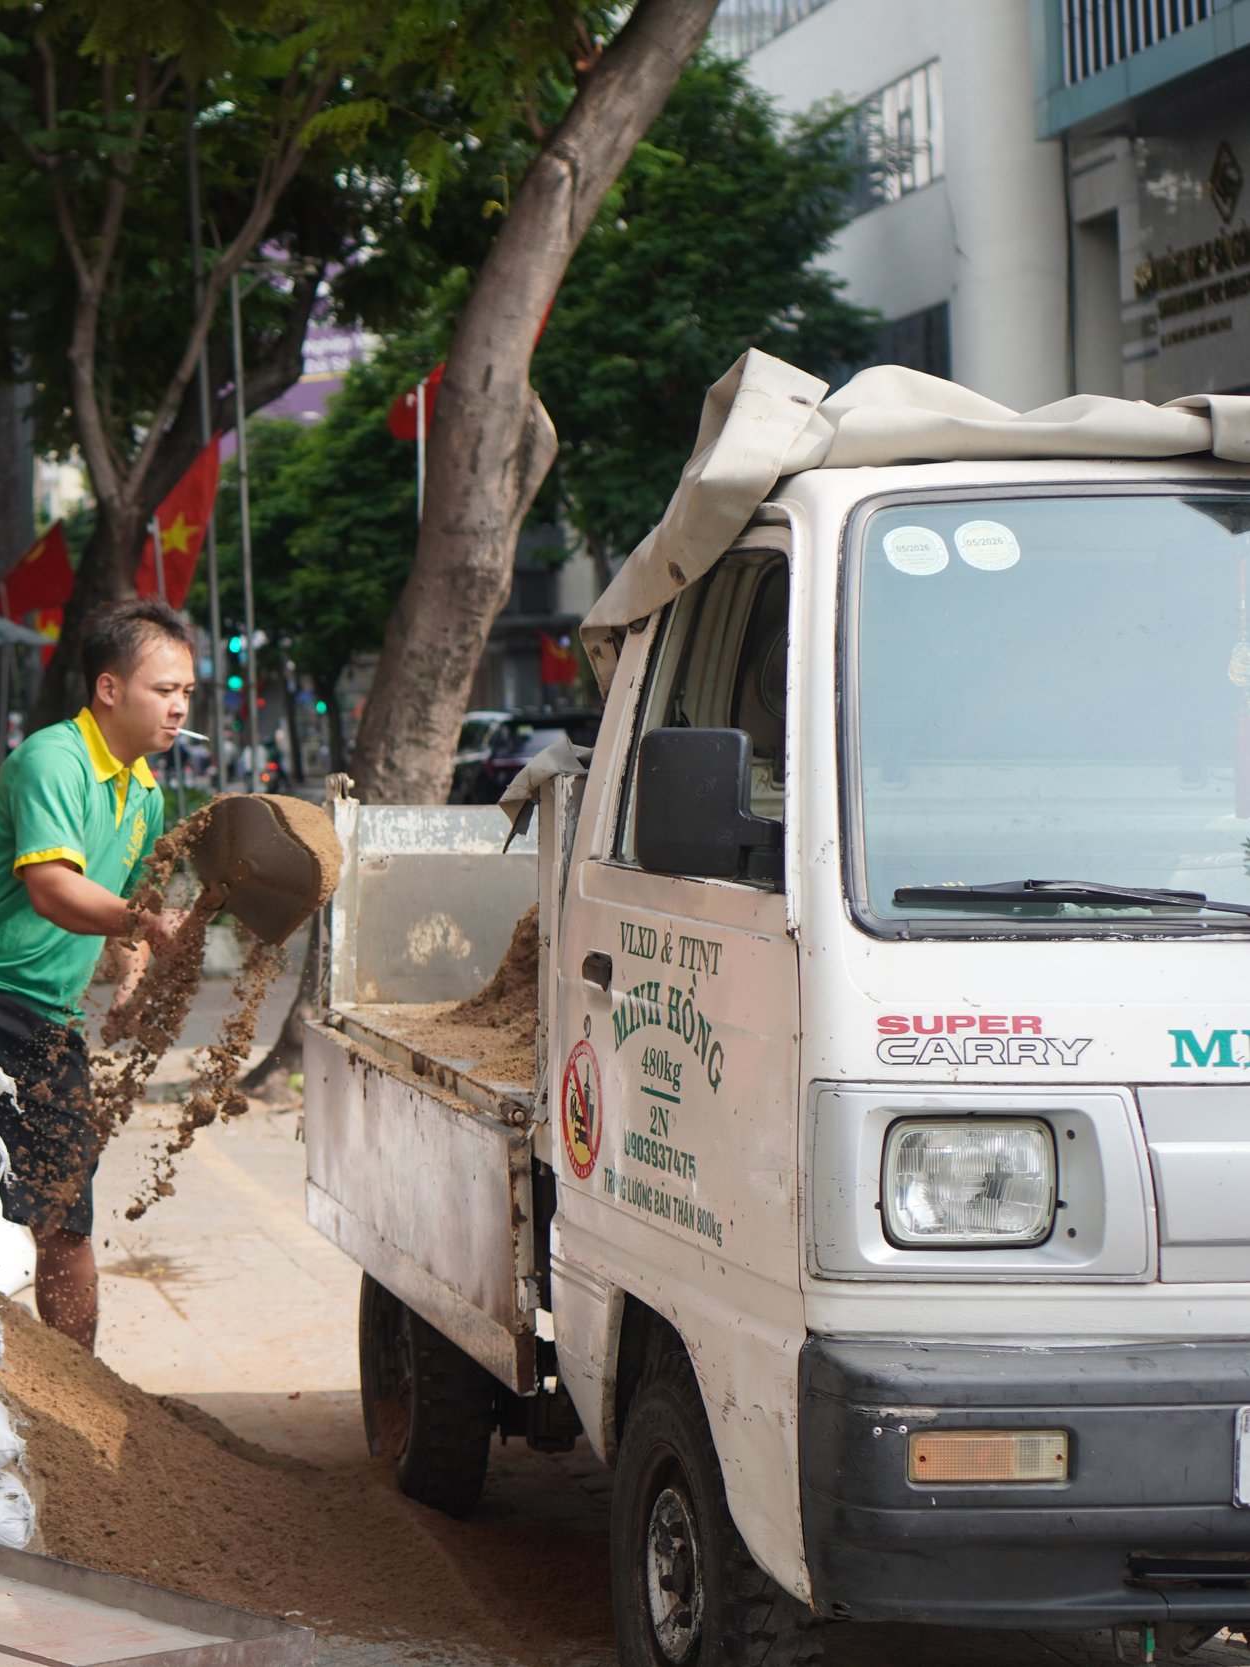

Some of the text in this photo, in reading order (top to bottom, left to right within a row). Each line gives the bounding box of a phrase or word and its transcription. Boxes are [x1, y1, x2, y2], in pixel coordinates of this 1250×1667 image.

[619, 921, 723, 976] VLXD & TTNT
[612, 981, 661, 1053] MINH
[667, 973, 725, 1095] HỒNG
[876, 1015, 1042, 1035] SUPER
[641, 1046, 682, 1092] 480kg
[876, 1037, 1093, 1065] CARRY
[650, 1105, 669, 1139] 2N
[673, 1194, 695, 1230] THÂN
[697, 1207, 723, 1248] 800kg
